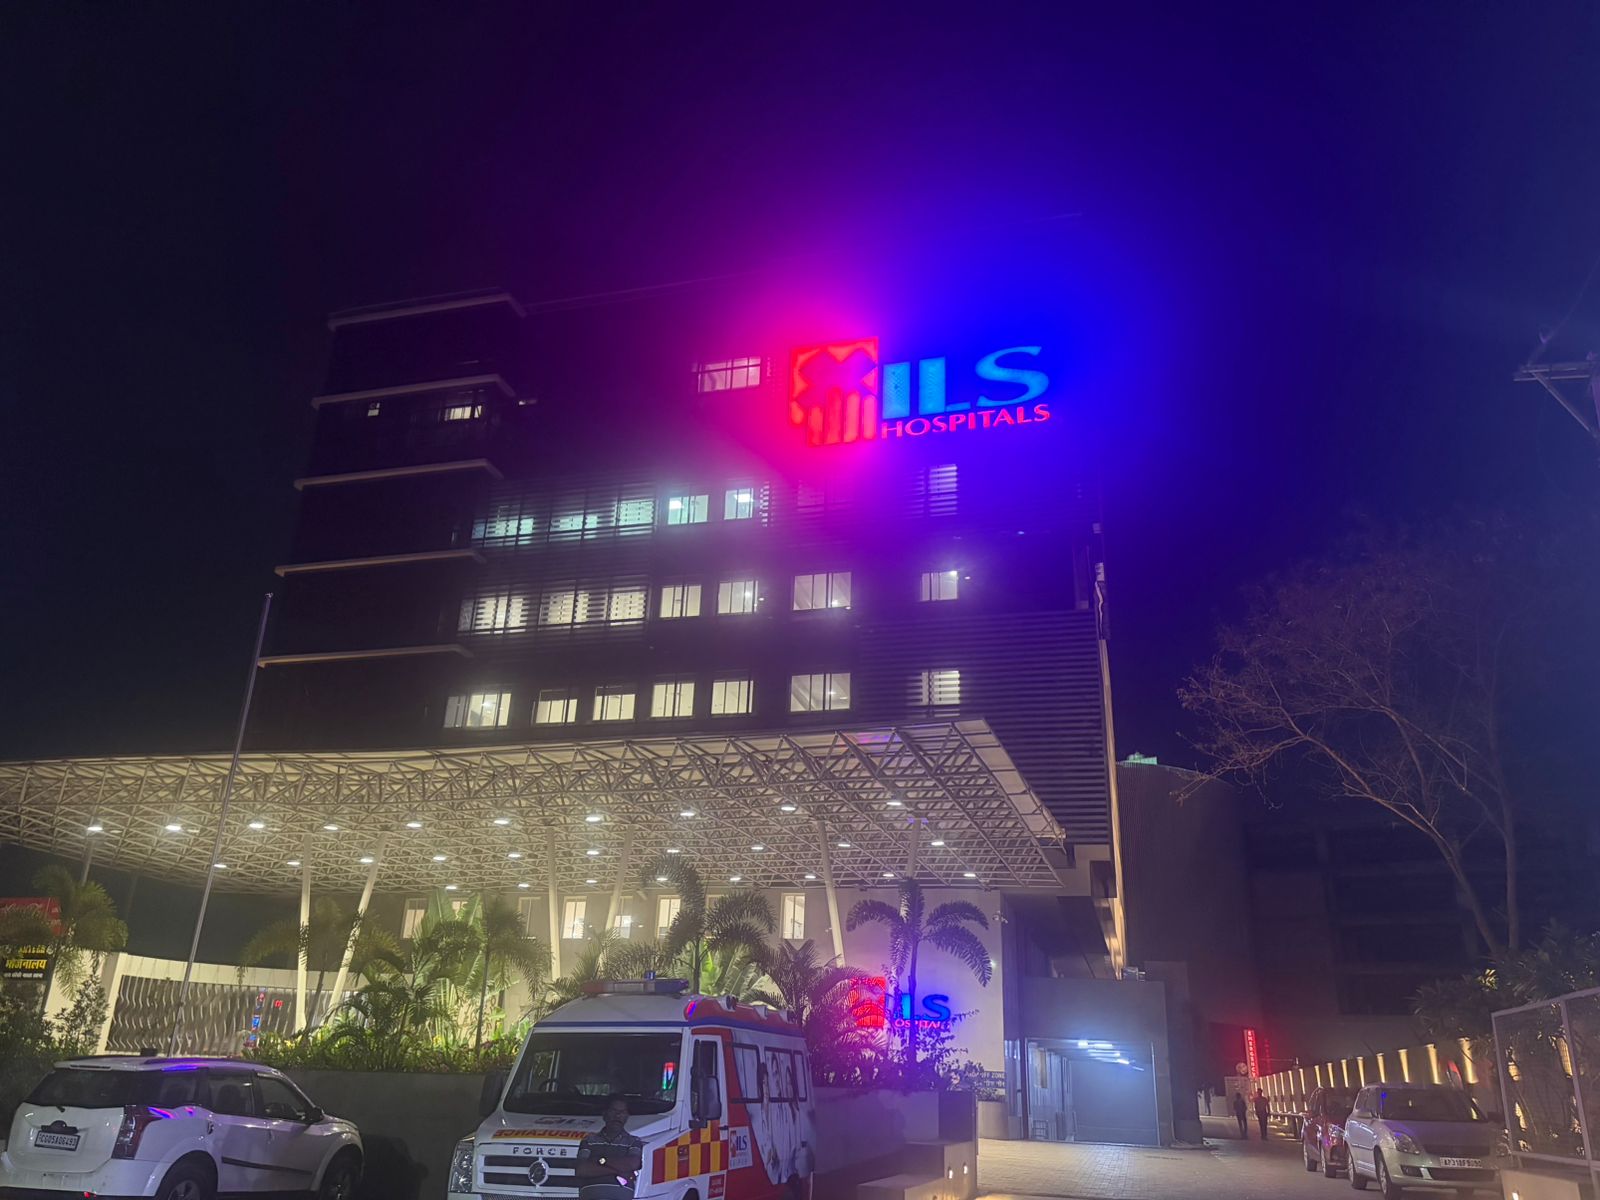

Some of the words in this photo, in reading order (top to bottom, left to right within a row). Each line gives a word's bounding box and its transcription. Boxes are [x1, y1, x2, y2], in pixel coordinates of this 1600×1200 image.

[882, 346, 1050, 420] ILS
[881, 404, 1051, 439] HOSPITALS
[512, 1146, 568, 1156] FORCE
[736, 1135, 748, 1151] ILS
